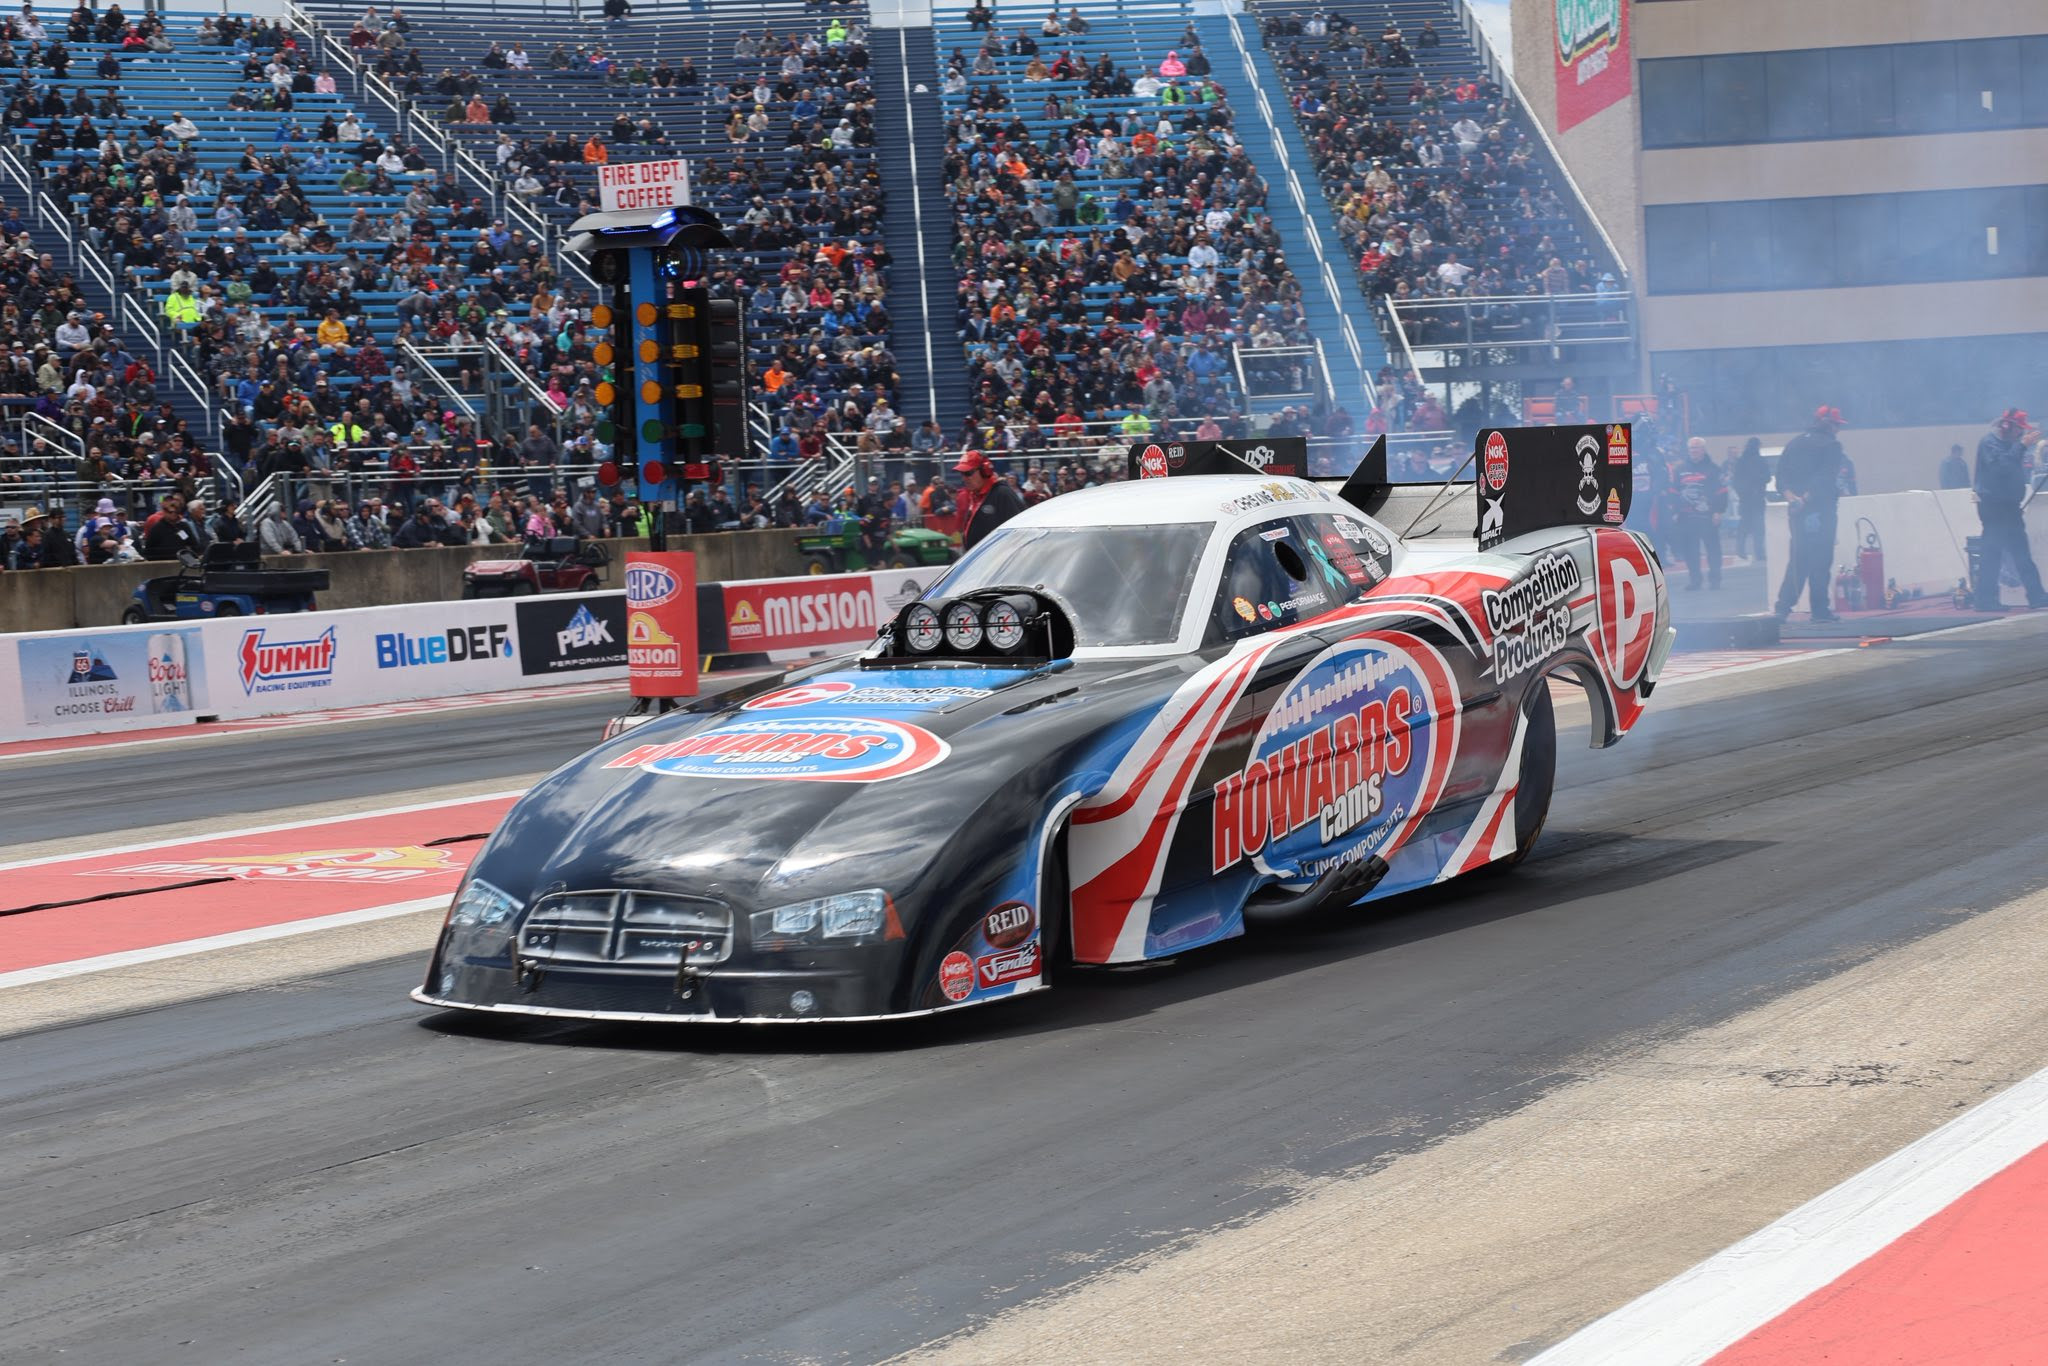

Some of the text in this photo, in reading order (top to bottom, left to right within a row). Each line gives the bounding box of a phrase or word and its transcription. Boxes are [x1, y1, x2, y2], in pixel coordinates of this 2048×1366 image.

[602, 161, 684, 187] FIRE DEPT.
[617, 185, 674, 209] COFFEE
[1168, 446, 1185, 459] REID
[1244, 446, 1275, 468] DSR
[1488, 445, 1504, 459] NGK
[1489, 463, 1505, 471] SPARK
[1489, 472, 1506, 480] PLUGS
[1480, 526, 1503, 543] IMPACT
[1279, 592, 1327, 612] PERFORMANCE
[1485, 555, 1578, 630] Competition
[763, 590, 874, 637] MISSION
[376, 624, 509, 669] BlueDEF
[556, 619, 615, 656] PEAK
[75, 658, 89, 670] 66
[549, 655, 628, 668] PERFORMANCE
[629, 647, 677, 664] ISSION
[154, 681, 187, 697] LIGHT
[256, 679, 332, 693] RACING EQUIPMENT
[55, 696, 136, 716] CHOOSE Chill
[602, 733, 889, 768] HOWARDS
[725, 763, 819, 775] COMPONENTS
[1212, 686, 1411, 875] HOWARDS
[1340, 803, 1405, 864] COMPONENTS
[988, 906, 1029, 935] REID
[944, 962, 969, 977] NGK
